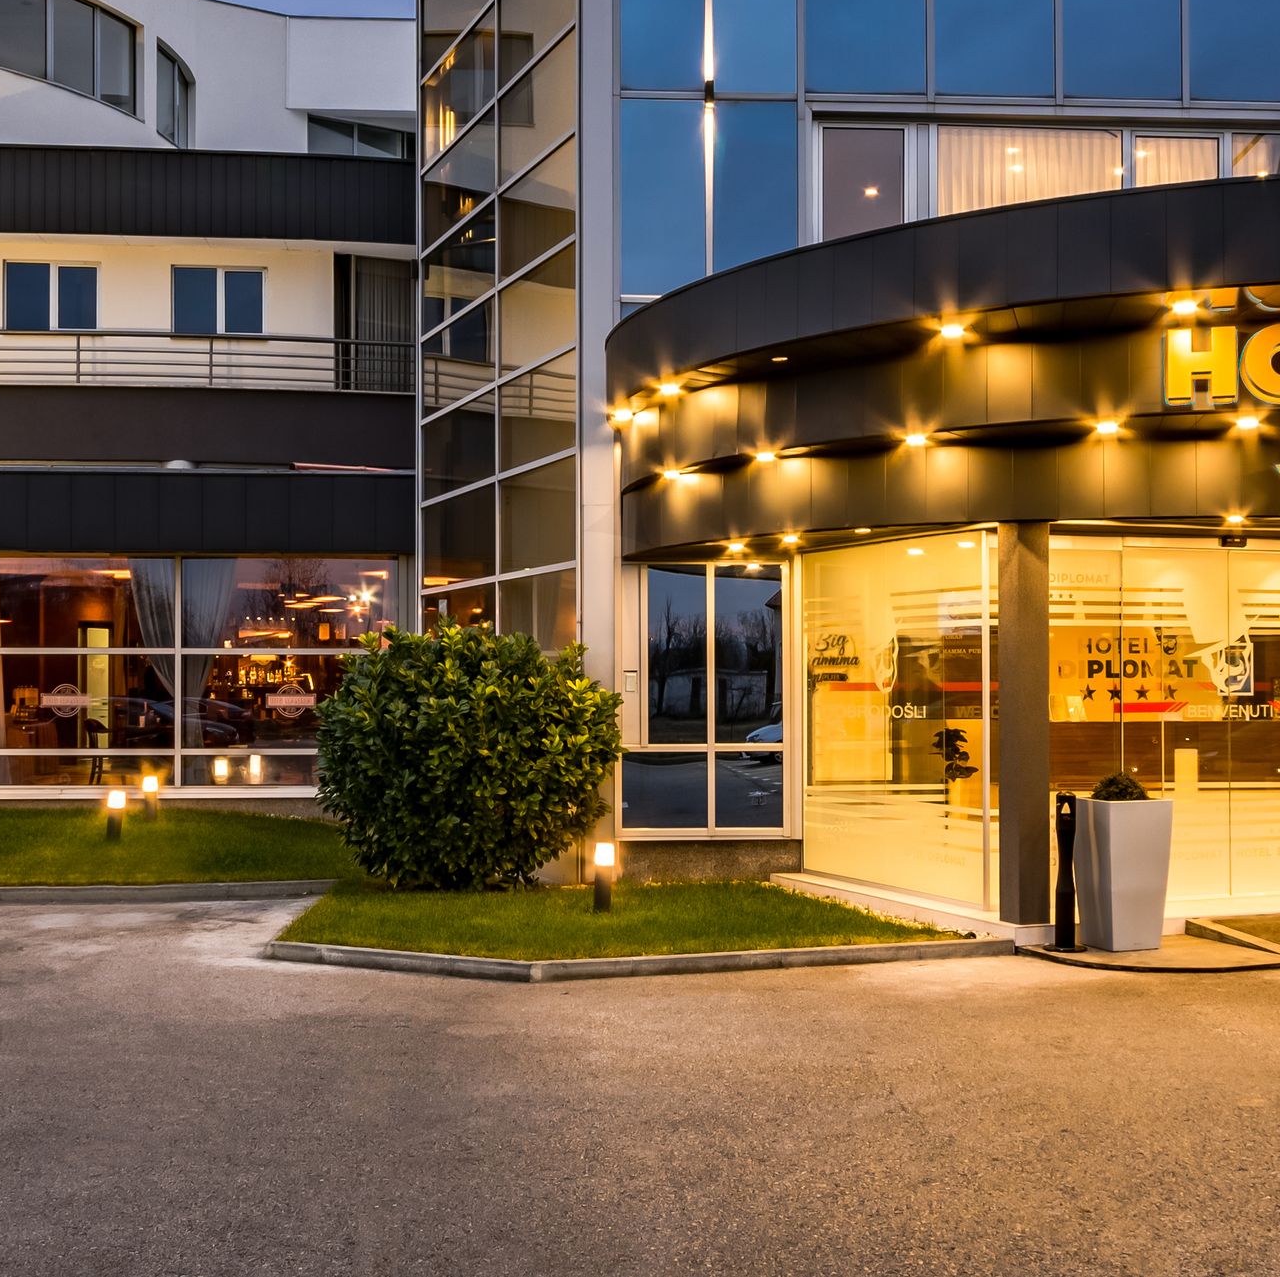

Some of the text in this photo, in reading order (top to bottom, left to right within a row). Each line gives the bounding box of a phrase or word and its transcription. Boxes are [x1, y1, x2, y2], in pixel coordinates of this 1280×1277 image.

[1078, 637, 1152, 654] HOTEL
[1057, 659, 1198, 679] DIPLOMAT
[1186, 704, 1274, 719] BENVENUTI
